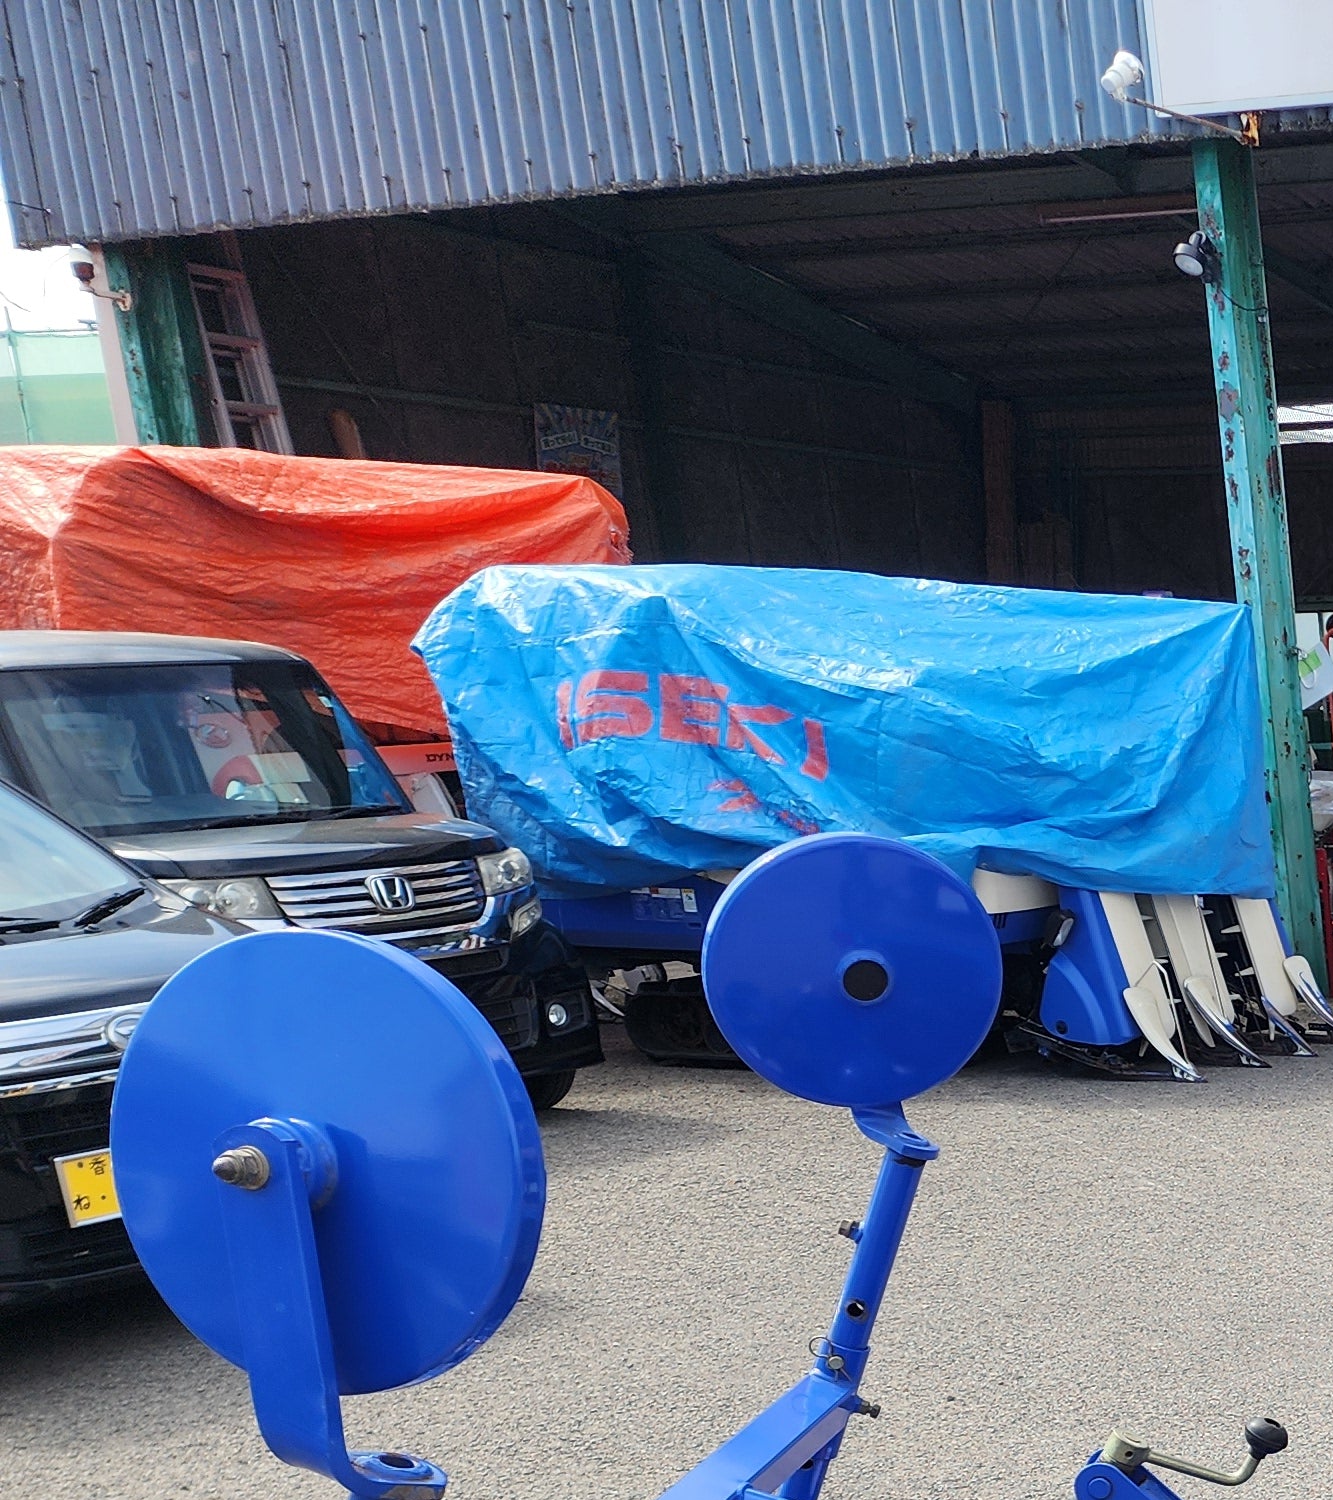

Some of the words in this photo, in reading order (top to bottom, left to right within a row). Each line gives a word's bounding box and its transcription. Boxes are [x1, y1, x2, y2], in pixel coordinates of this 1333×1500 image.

[556, 669, 829, 782] ISEKI
[425, 753, 455, 762] DYN
[89, 1157, 107, 1176] 香
[73, 1194, 91, 1211] ね
